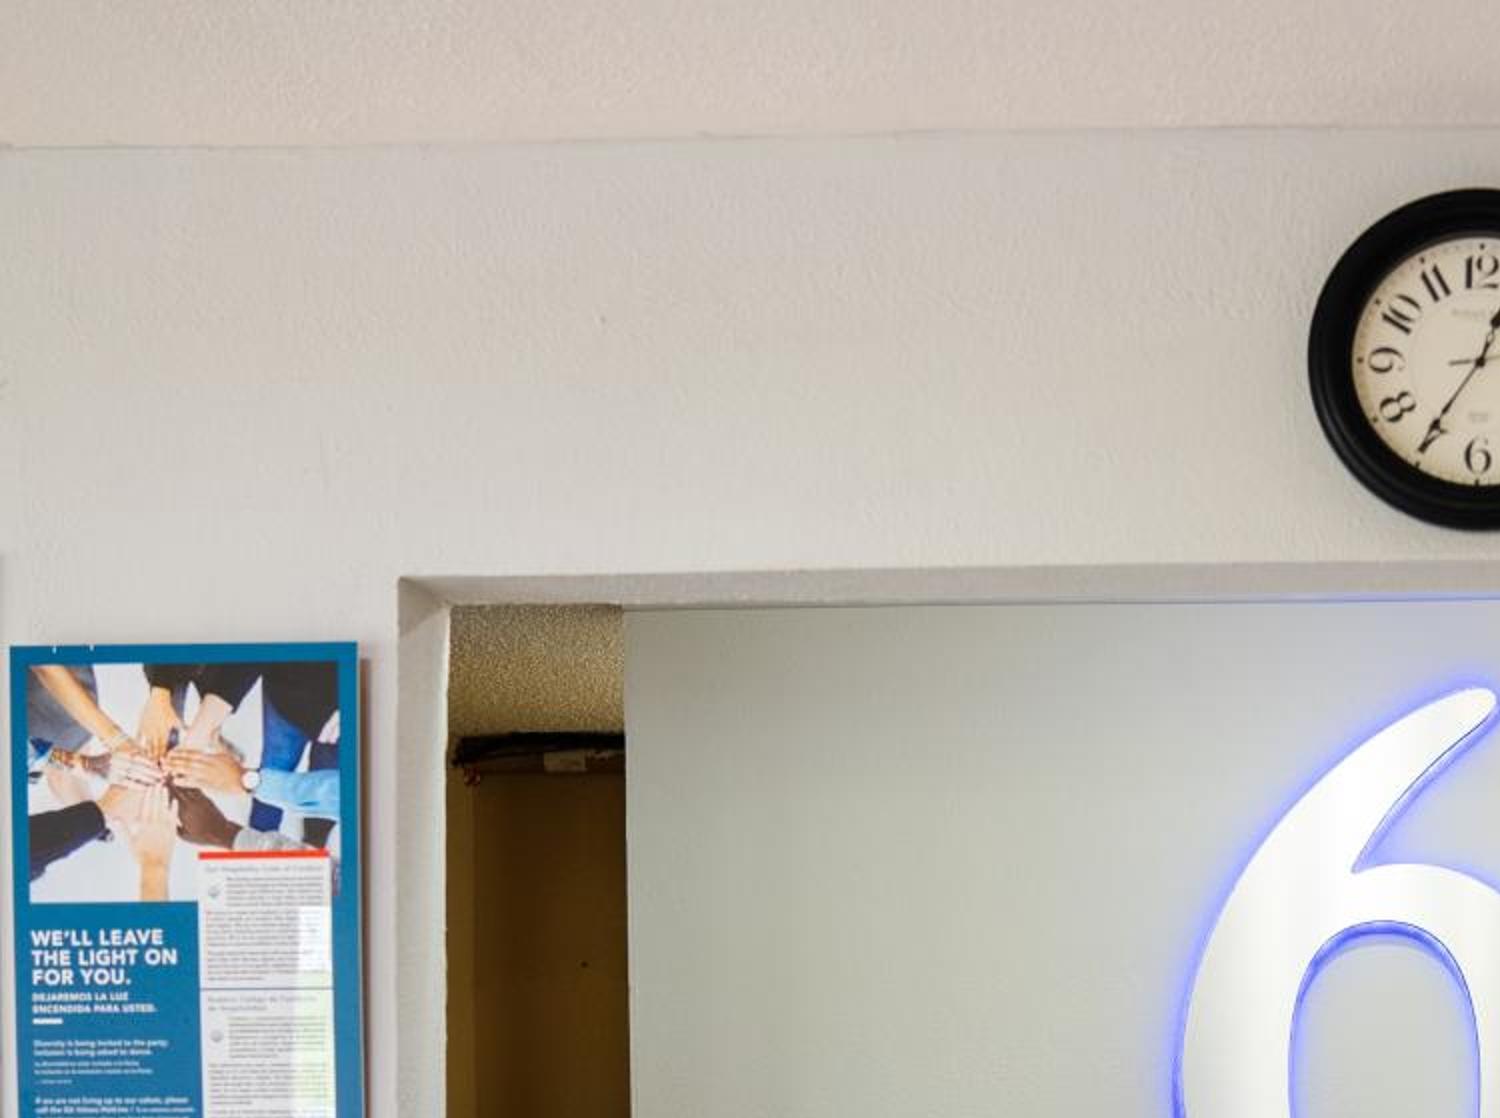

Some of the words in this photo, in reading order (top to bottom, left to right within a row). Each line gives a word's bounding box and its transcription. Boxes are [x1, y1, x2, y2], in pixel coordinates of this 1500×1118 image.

[1421, 264, 1451, 302] 11
[1464, 255, 1500, 289] 12
[1381, 294, 1422, 334] 10
[1368, 347, 1404, 374] 9
[1379, 390, 1417, 423] 8
[1464, 437, 1491, 474] 6
[31, 929, 93, 946] WE'LL
[100, 928, 164, 945] LEAVE
[31, 949, 72, 966] THE
[78, 949, 139, 966] LIGHT
[144, 948, 178, 965] ON
[32, 969, 74, 986] FOR
[80, 968, 132, 986] YOU.
